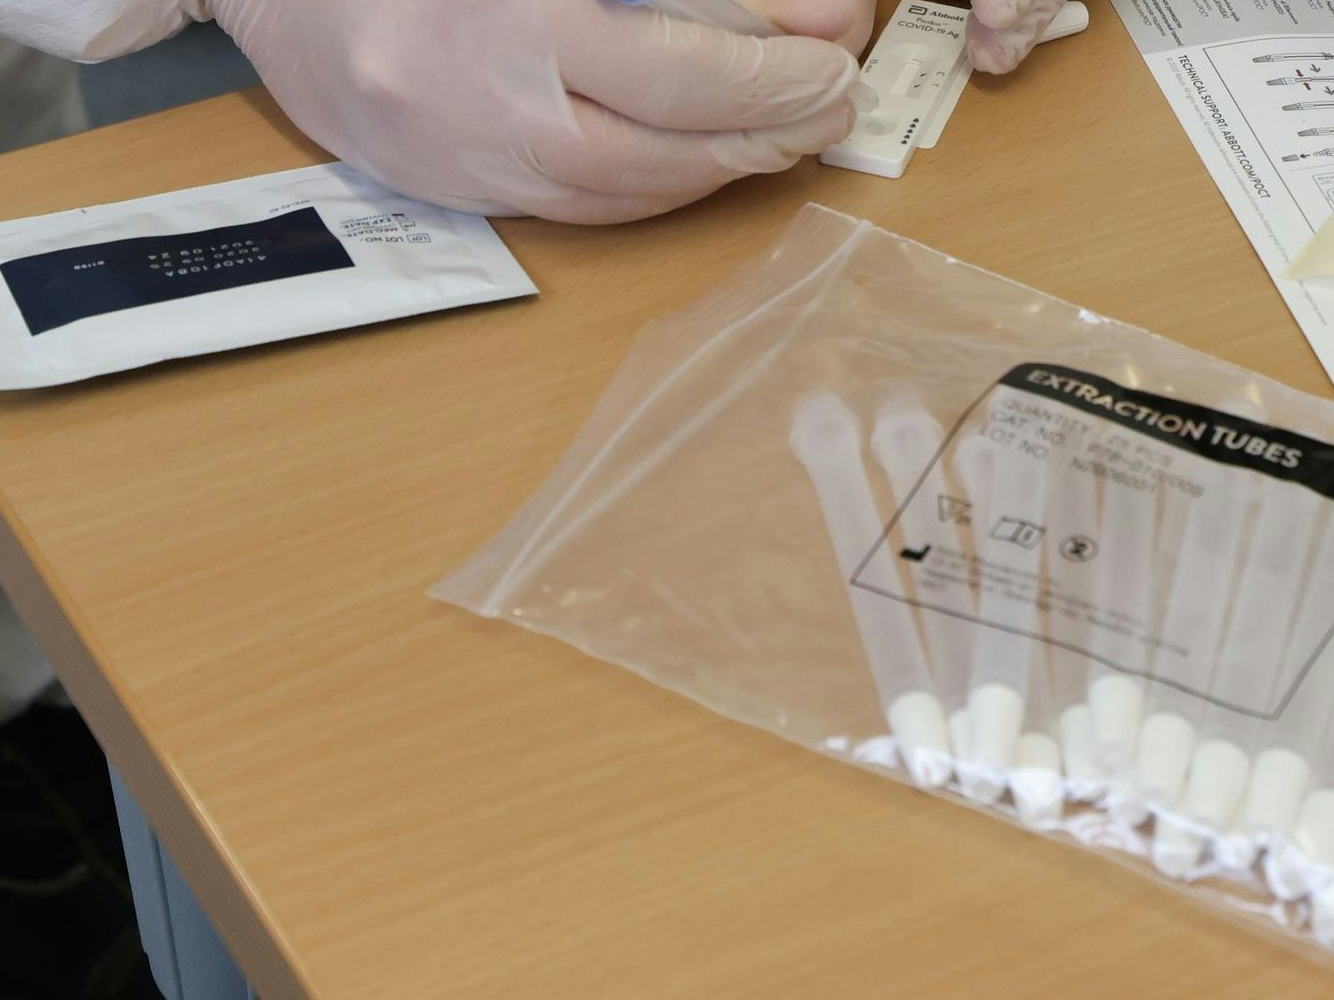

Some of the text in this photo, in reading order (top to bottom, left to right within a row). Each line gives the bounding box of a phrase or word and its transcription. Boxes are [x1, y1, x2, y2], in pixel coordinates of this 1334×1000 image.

[898, 20, 946, 34] COVID-19
[930, 10, 964, 22] Abbott
[1178, 54, 1271, 200] TECHNICAL SUPPORT: ABBOTT.COM/POCT
[1026, 369, 1303, 469] EXTRACTION TUBES
